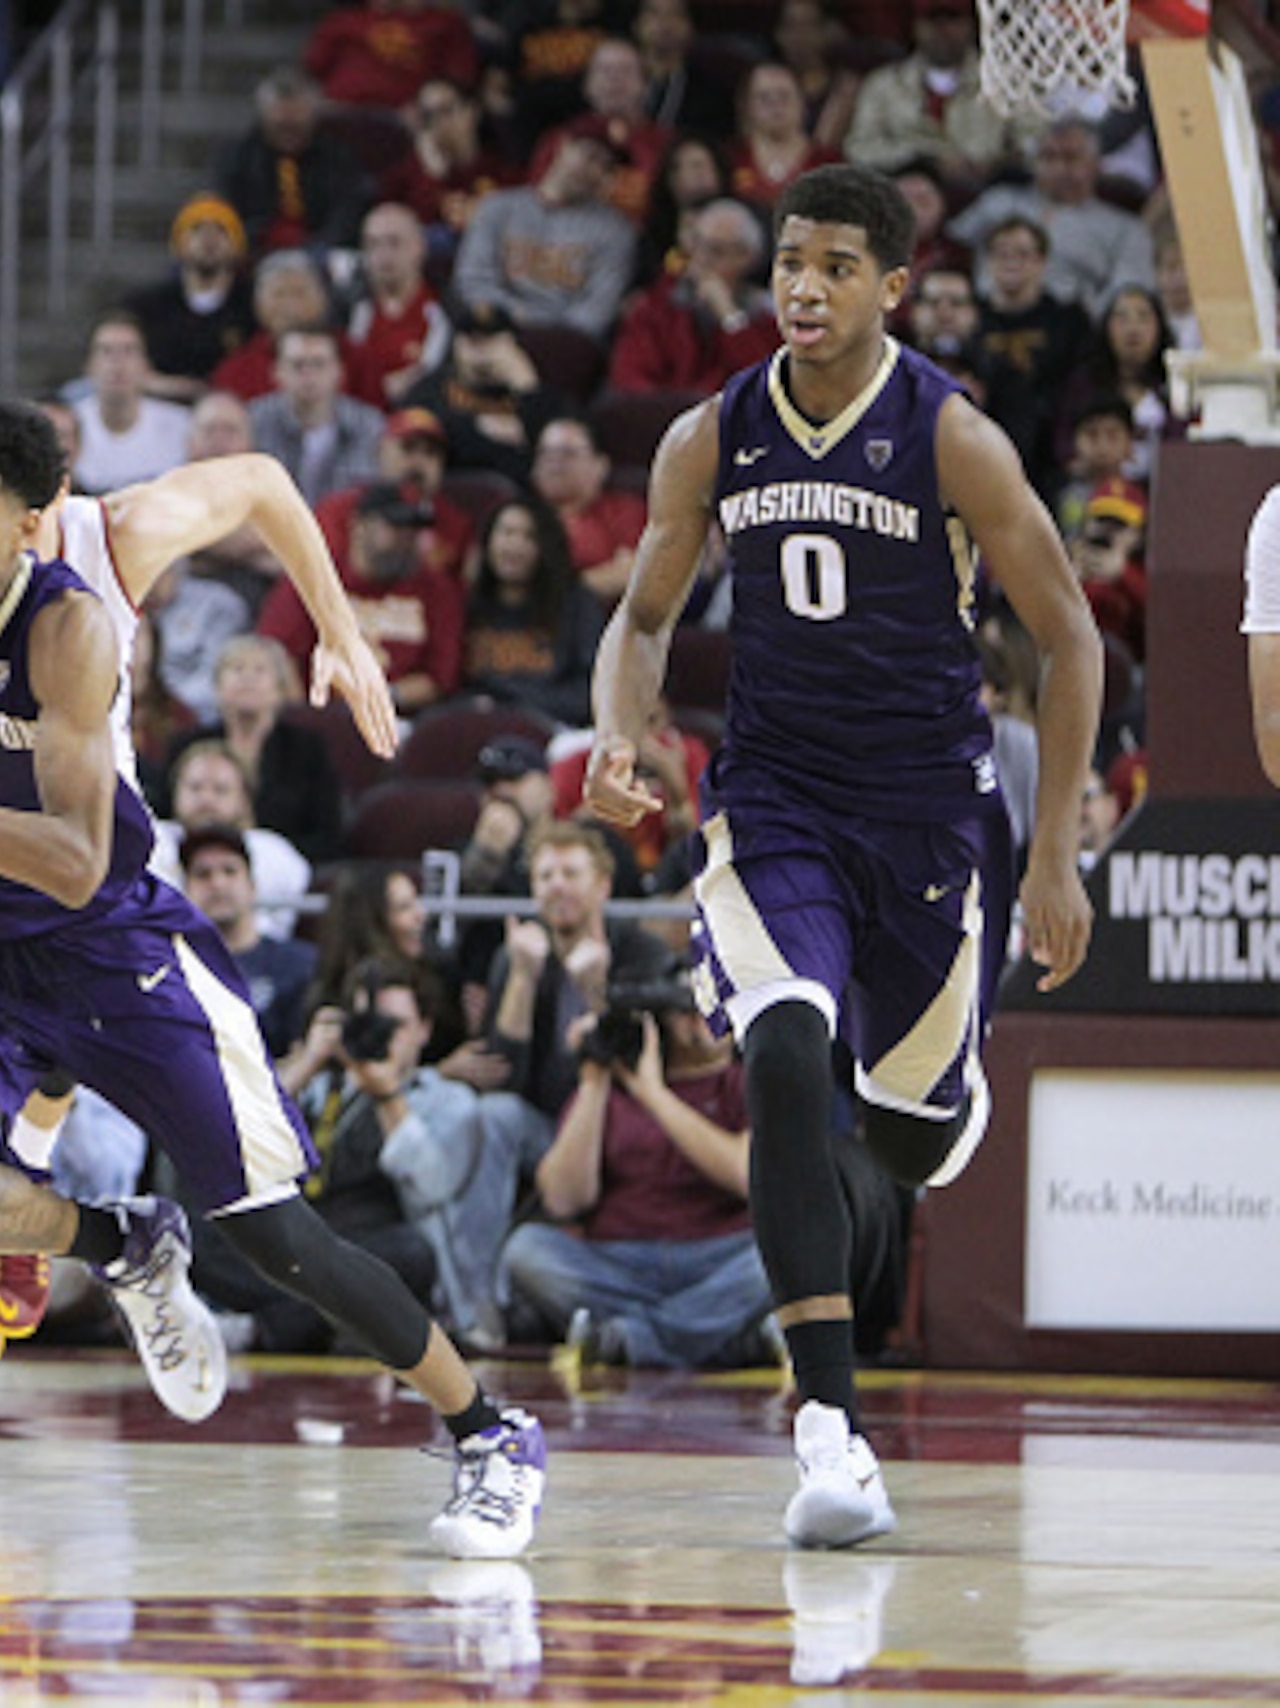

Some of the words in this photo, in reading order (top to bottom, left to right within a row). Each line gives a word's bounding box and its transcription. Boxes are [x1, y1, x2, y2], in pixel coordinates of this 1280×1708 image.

[719, 480, 919, 543] WASHINGTON
[780, 532, 847, 621] 0
[1148, 916, 1280, 983] MILK
[1046, 1178, 1121, 1214] Keck
[1132, 1179, 1273, 1219] Medicine
